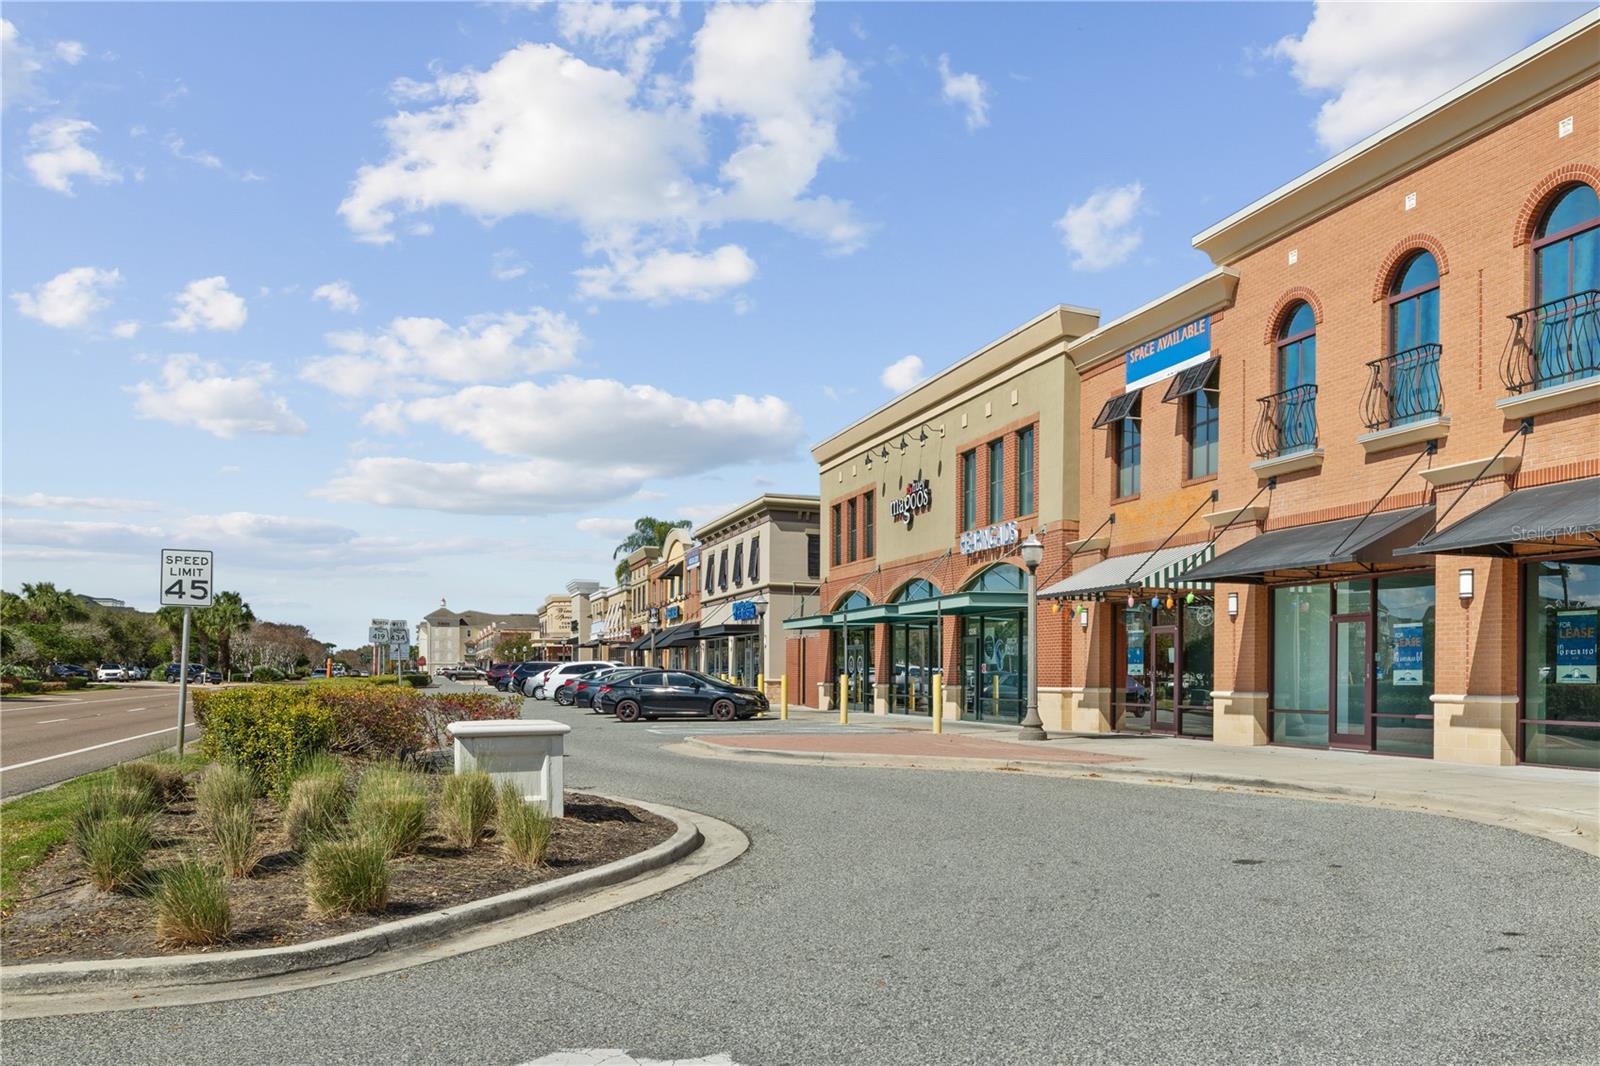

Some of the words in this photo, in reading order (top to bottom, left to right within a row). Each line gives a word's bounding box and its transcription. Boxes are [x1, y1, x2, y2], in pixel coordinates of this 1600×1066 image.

[1129, 341, 1156, 364] SPACE
[1156, 319, 1206, 353] AVAILABLE
[166, 555, 209, 566] SPEED
[170, 567, 204, 577] LIMIT
[164, 579, 209, 600] 45
[390, 634, 406, 642] 434
[1559, 627, 1595, 639] LEASE
